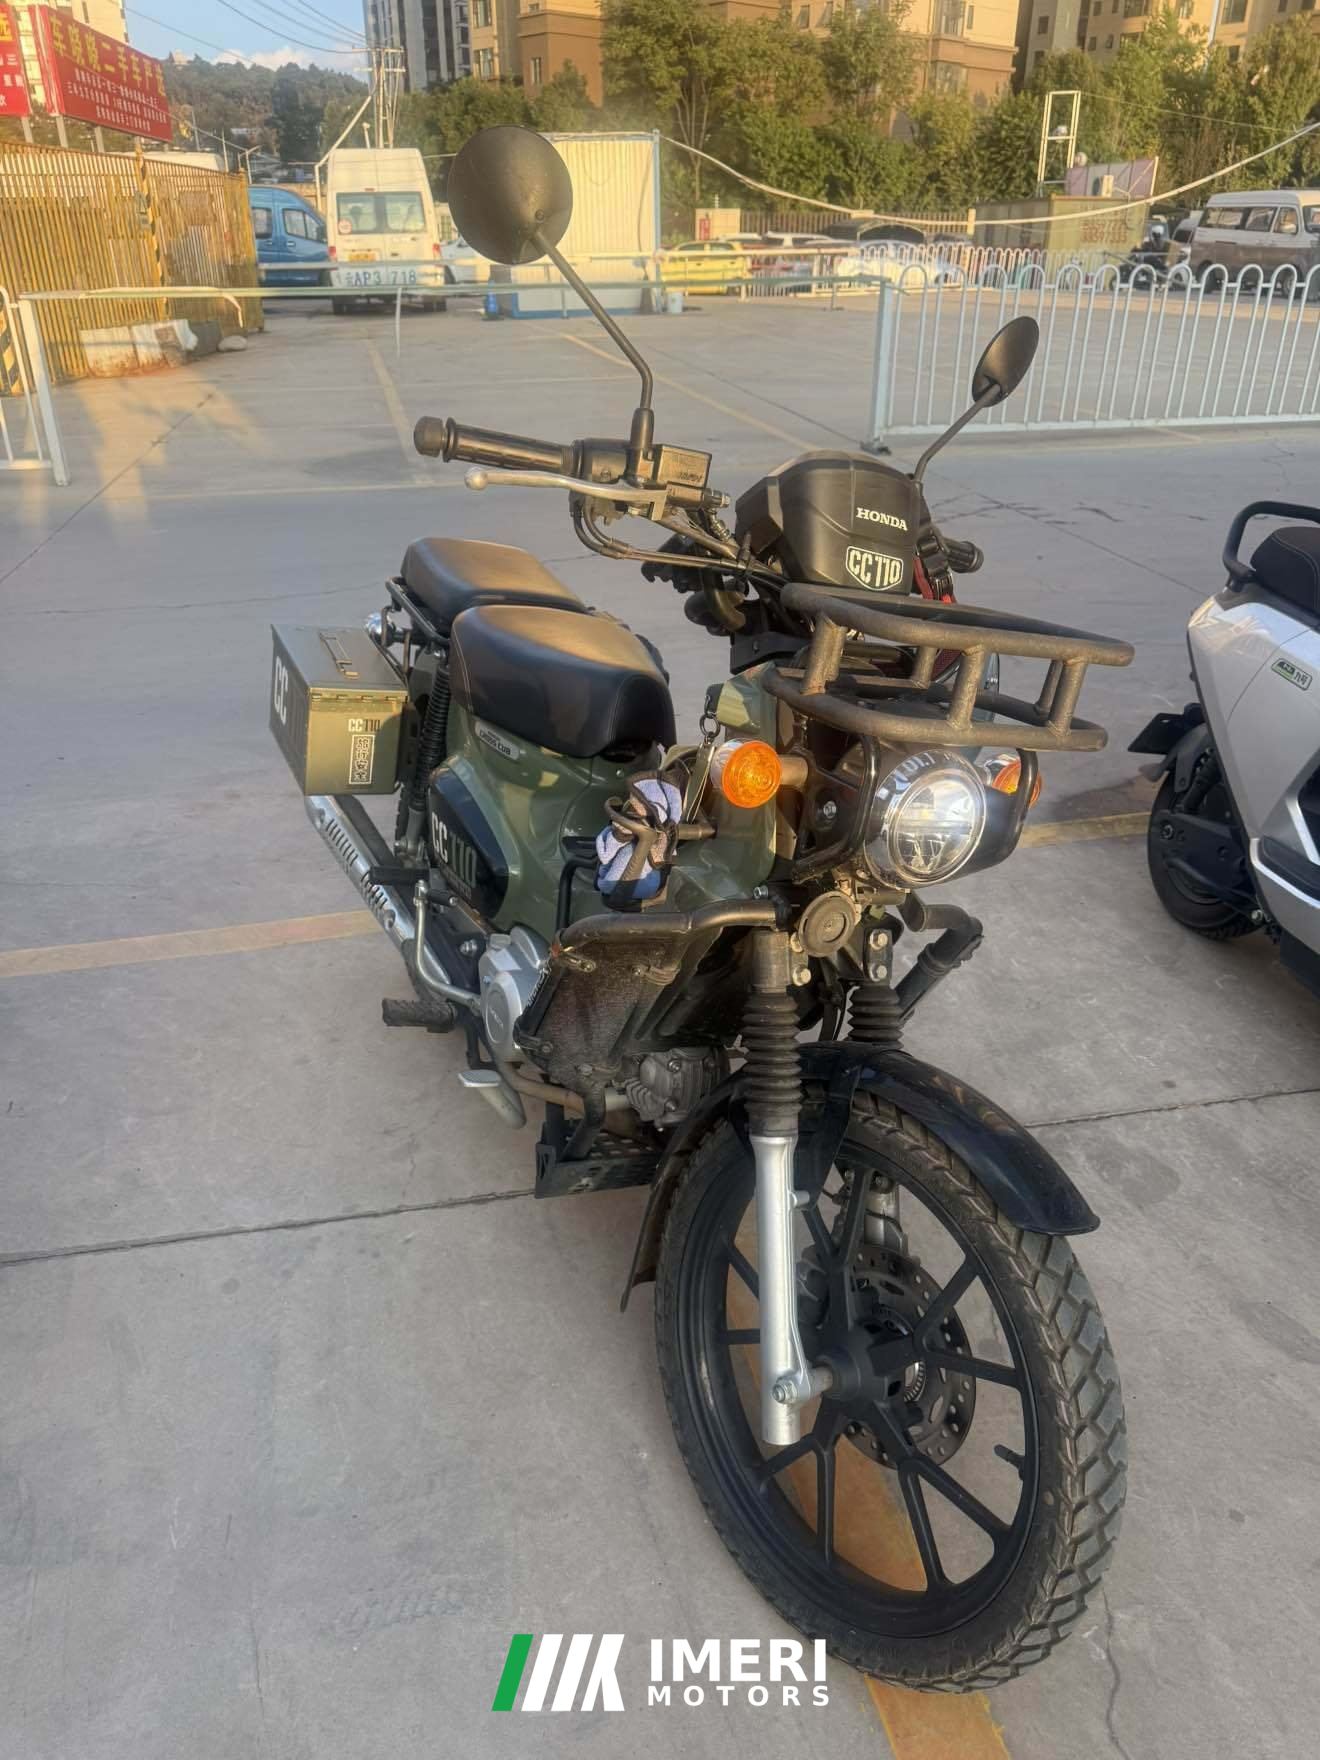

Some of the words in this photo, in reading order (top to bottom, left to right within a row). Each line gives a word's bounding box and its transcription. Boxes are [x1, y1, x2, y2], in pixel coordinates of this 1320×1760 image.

[856, 507, 908, 531] HONDA
[849, 550, 901, 587] CC110
[274, 656, 288, 726] CC
[348, 718, 381, 732] CC110
[431, 811, 477, 888] CC110
